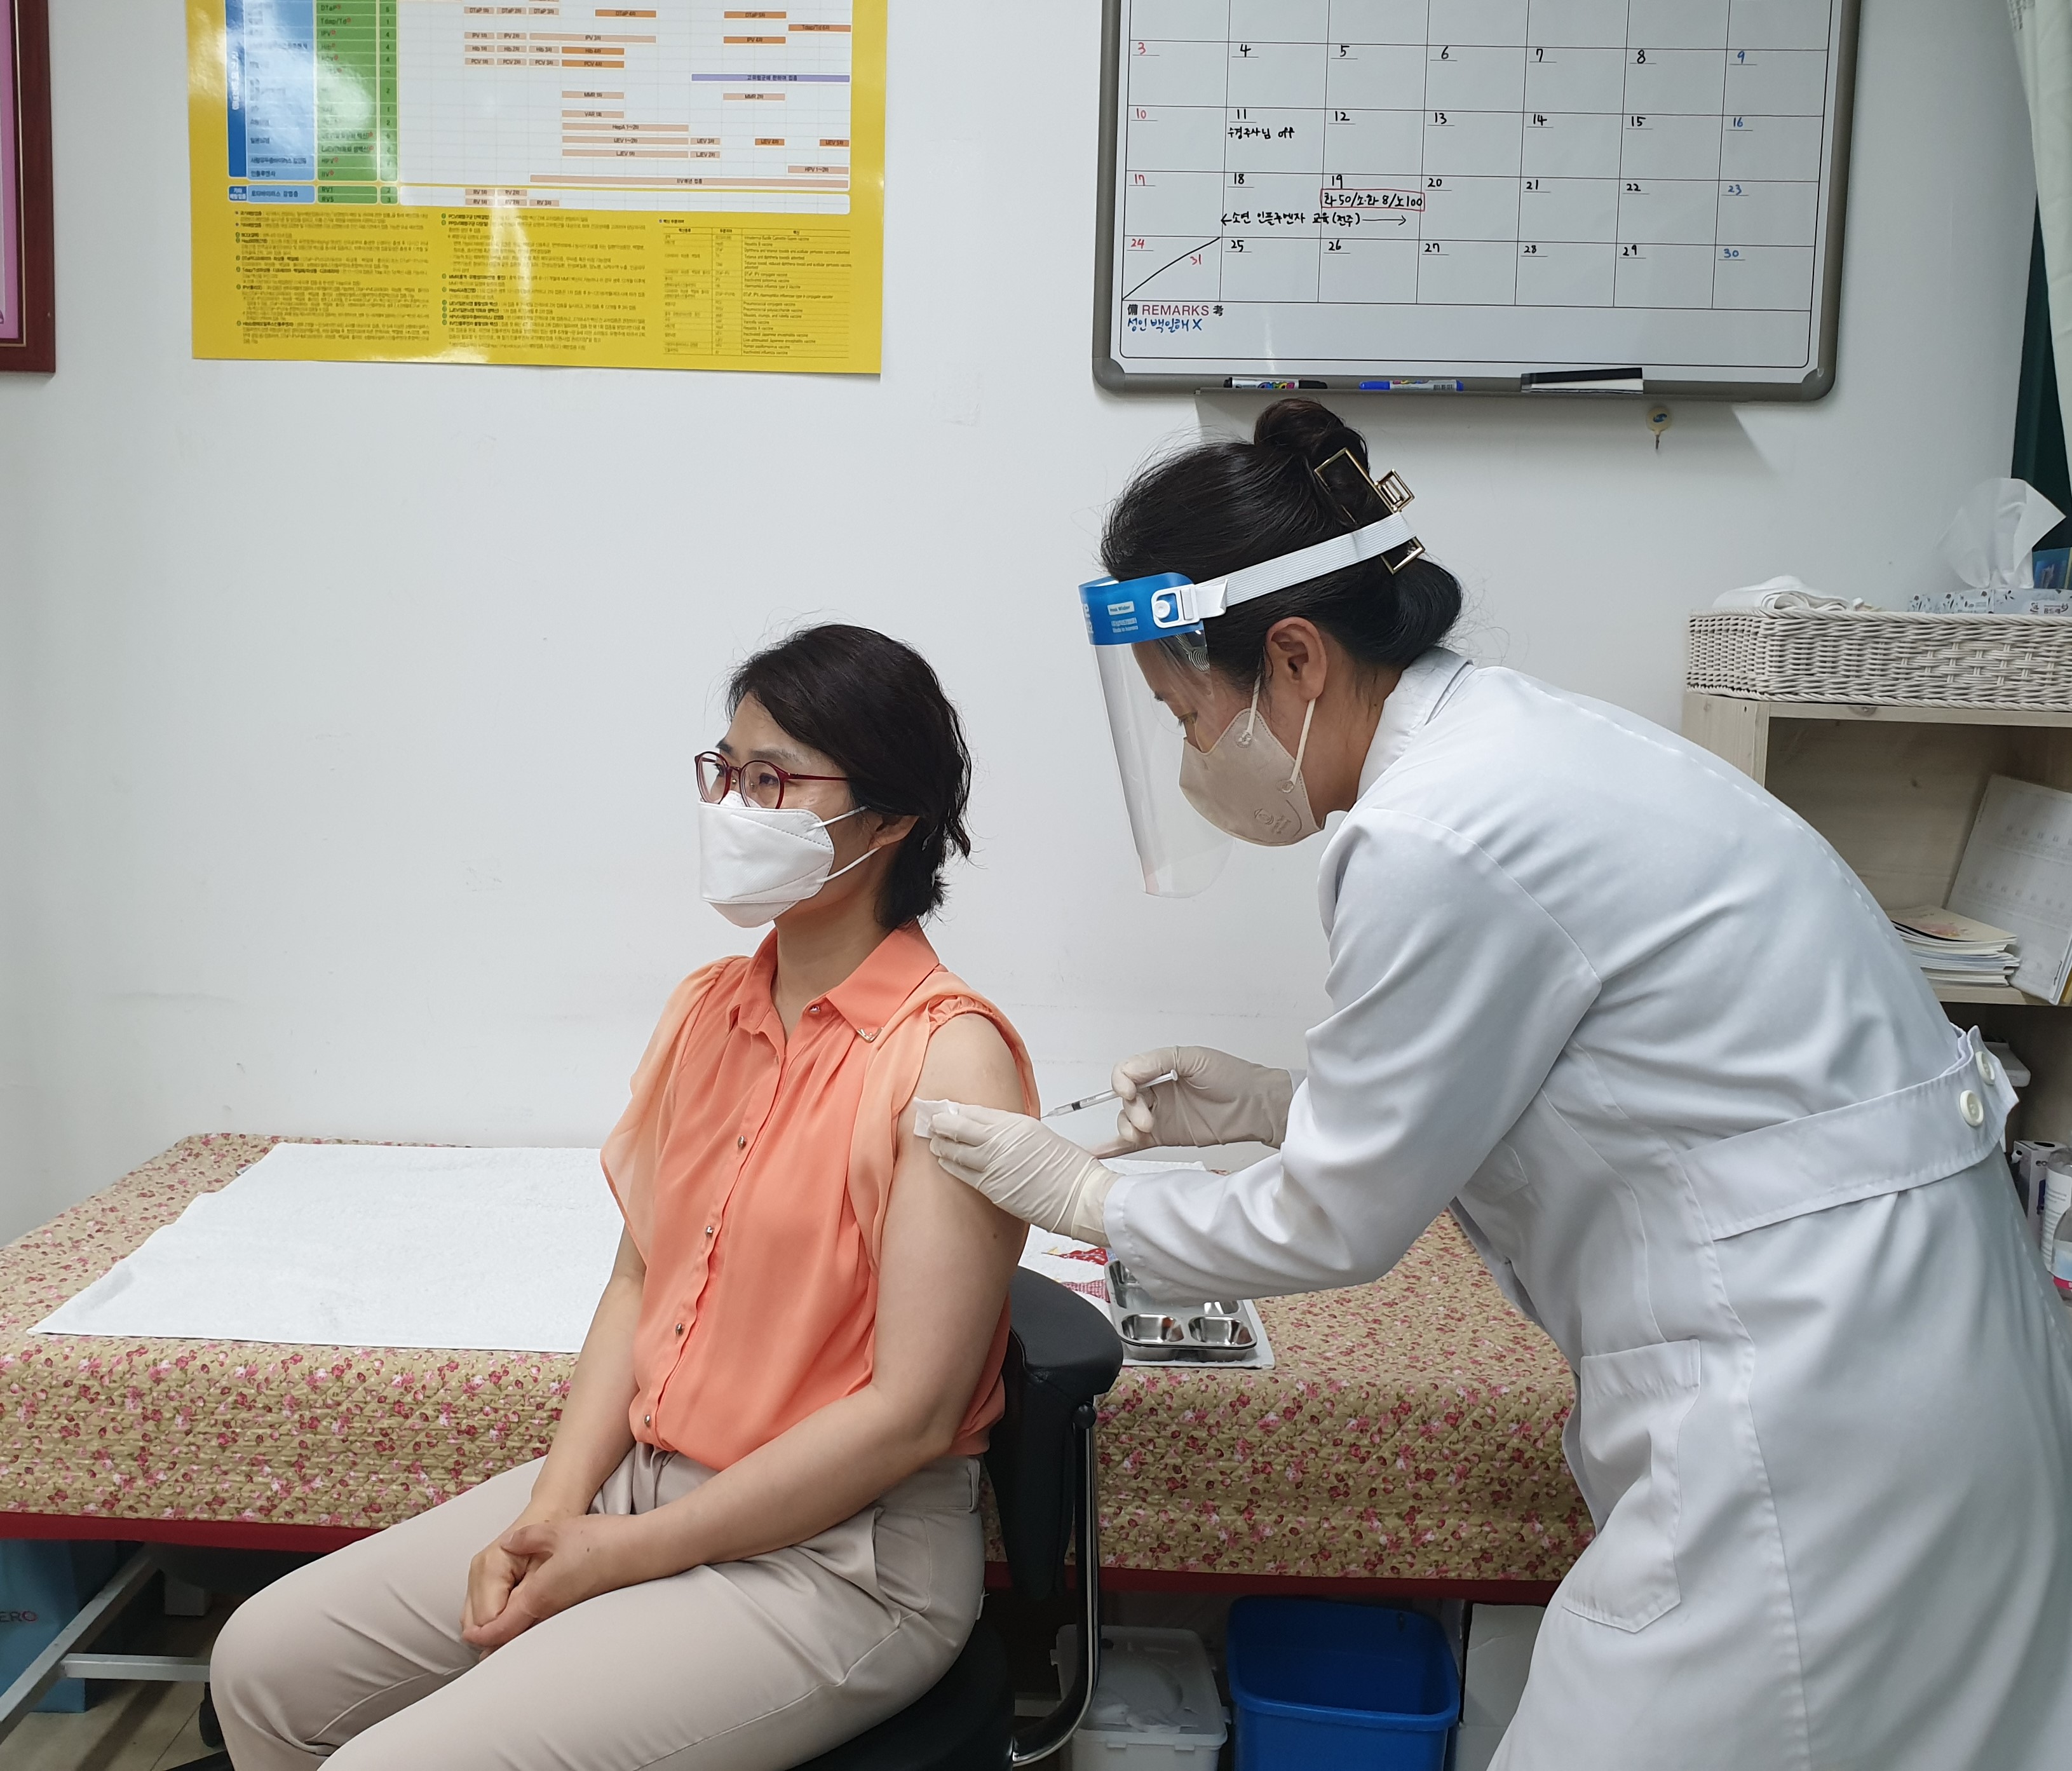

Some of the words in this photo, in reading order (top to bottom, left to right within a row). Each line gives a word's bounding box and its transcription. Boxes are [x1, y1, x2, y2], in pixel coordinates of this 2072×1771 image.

[1137, 42, 1146, 55] 3
[1240, 44, 1252, 57] 4
[1339, 45, 1350, 58] 5
[1440, 46, 1449, 60] 6
[1535, 48, 1544, 62] 7
[1636, 49, 1646, 64] 8
[1737, 50, 1745, 64] 9
[1135, 108, 1147, 119] 10
[1236, 108, 1247, 119] 11
[1334, 111, 1350, 122] 12
[1434, 112, 1448, 125] 13
[1533, 114, 1547, 126] 14
[1630, 116, 1646, 127] 15
[1732, 118, 1744, 128] 16
[1134, 174, 1146, 186] 17
[1233, 173, 1245, 185] 18
[1331, 173, 1343, 189] 19
[1427, 178, 1442, 188] 20
[1526, 179, 1539, 191] 21
[1626, 182, 1641, 192] 22
[1728, 185, 1742, 196] 23
[1130, 238, 1145, 249] 24
[1230, 239, 1245, 252] 25
[1328, 239, 1342, 252] 26
[1424, 242, 1440, 254] 27
[1523, 244, 1537, 254] 28
[1622, 245, 1638, 256] 29
[1723, 248, 1740, 259] 30
[1189, 254, 1202, 265] 31
[1142, 304, 1209, 316] REMARKS
[1127, 317, 1147, 332] 성인
